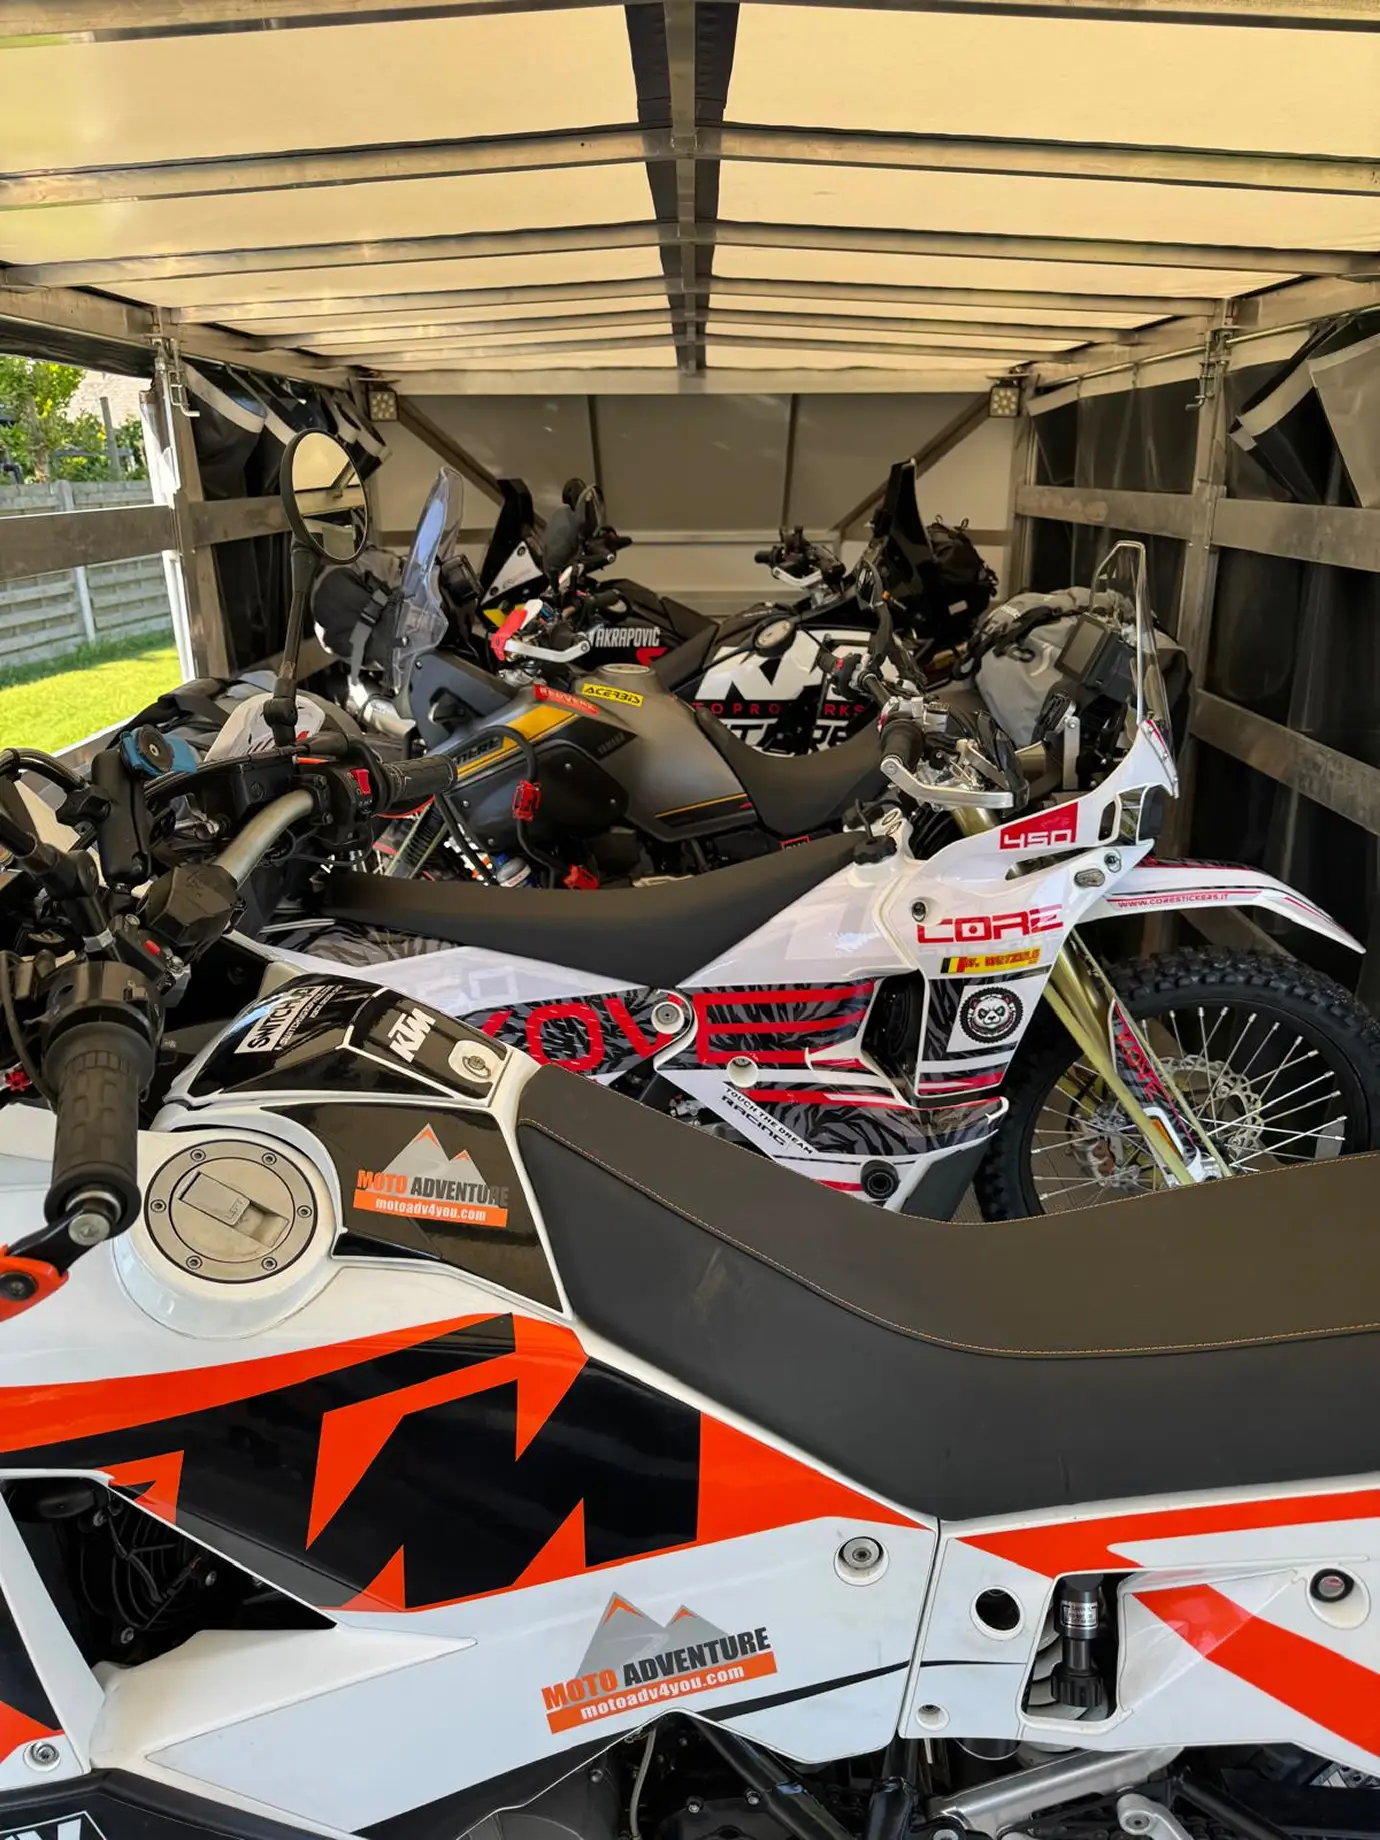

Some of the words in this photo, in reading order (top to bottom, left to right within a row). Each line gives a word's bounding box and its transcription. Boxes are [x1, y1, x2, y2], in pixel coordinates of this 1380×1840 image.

[584, 685, 641, 705] ACERBIS
[1004, 829, 1073, 849] 450
[917, 904, 1064, 944] CORE
[387, 1008, 436, 1063] KTM
[720, 1093, 786, 1146] RACING
[725, 1086, 757, 1112] TOUCH
[758, 1111, 777, 1128] THE
[778, 1126, 812, 1155] DREAM
[357, 1170, 408, 1194] MOTO
[410, 1176, 509, 1205] ADVENTURE
[375, 1197, 486, 1222] motoadv4you.com
[541, 1668, 618, 1711] MOTO
[623, 1626, 771, 1687] ADVENTURE
[581, 1665, 744, 1719] motoadv4you.com
